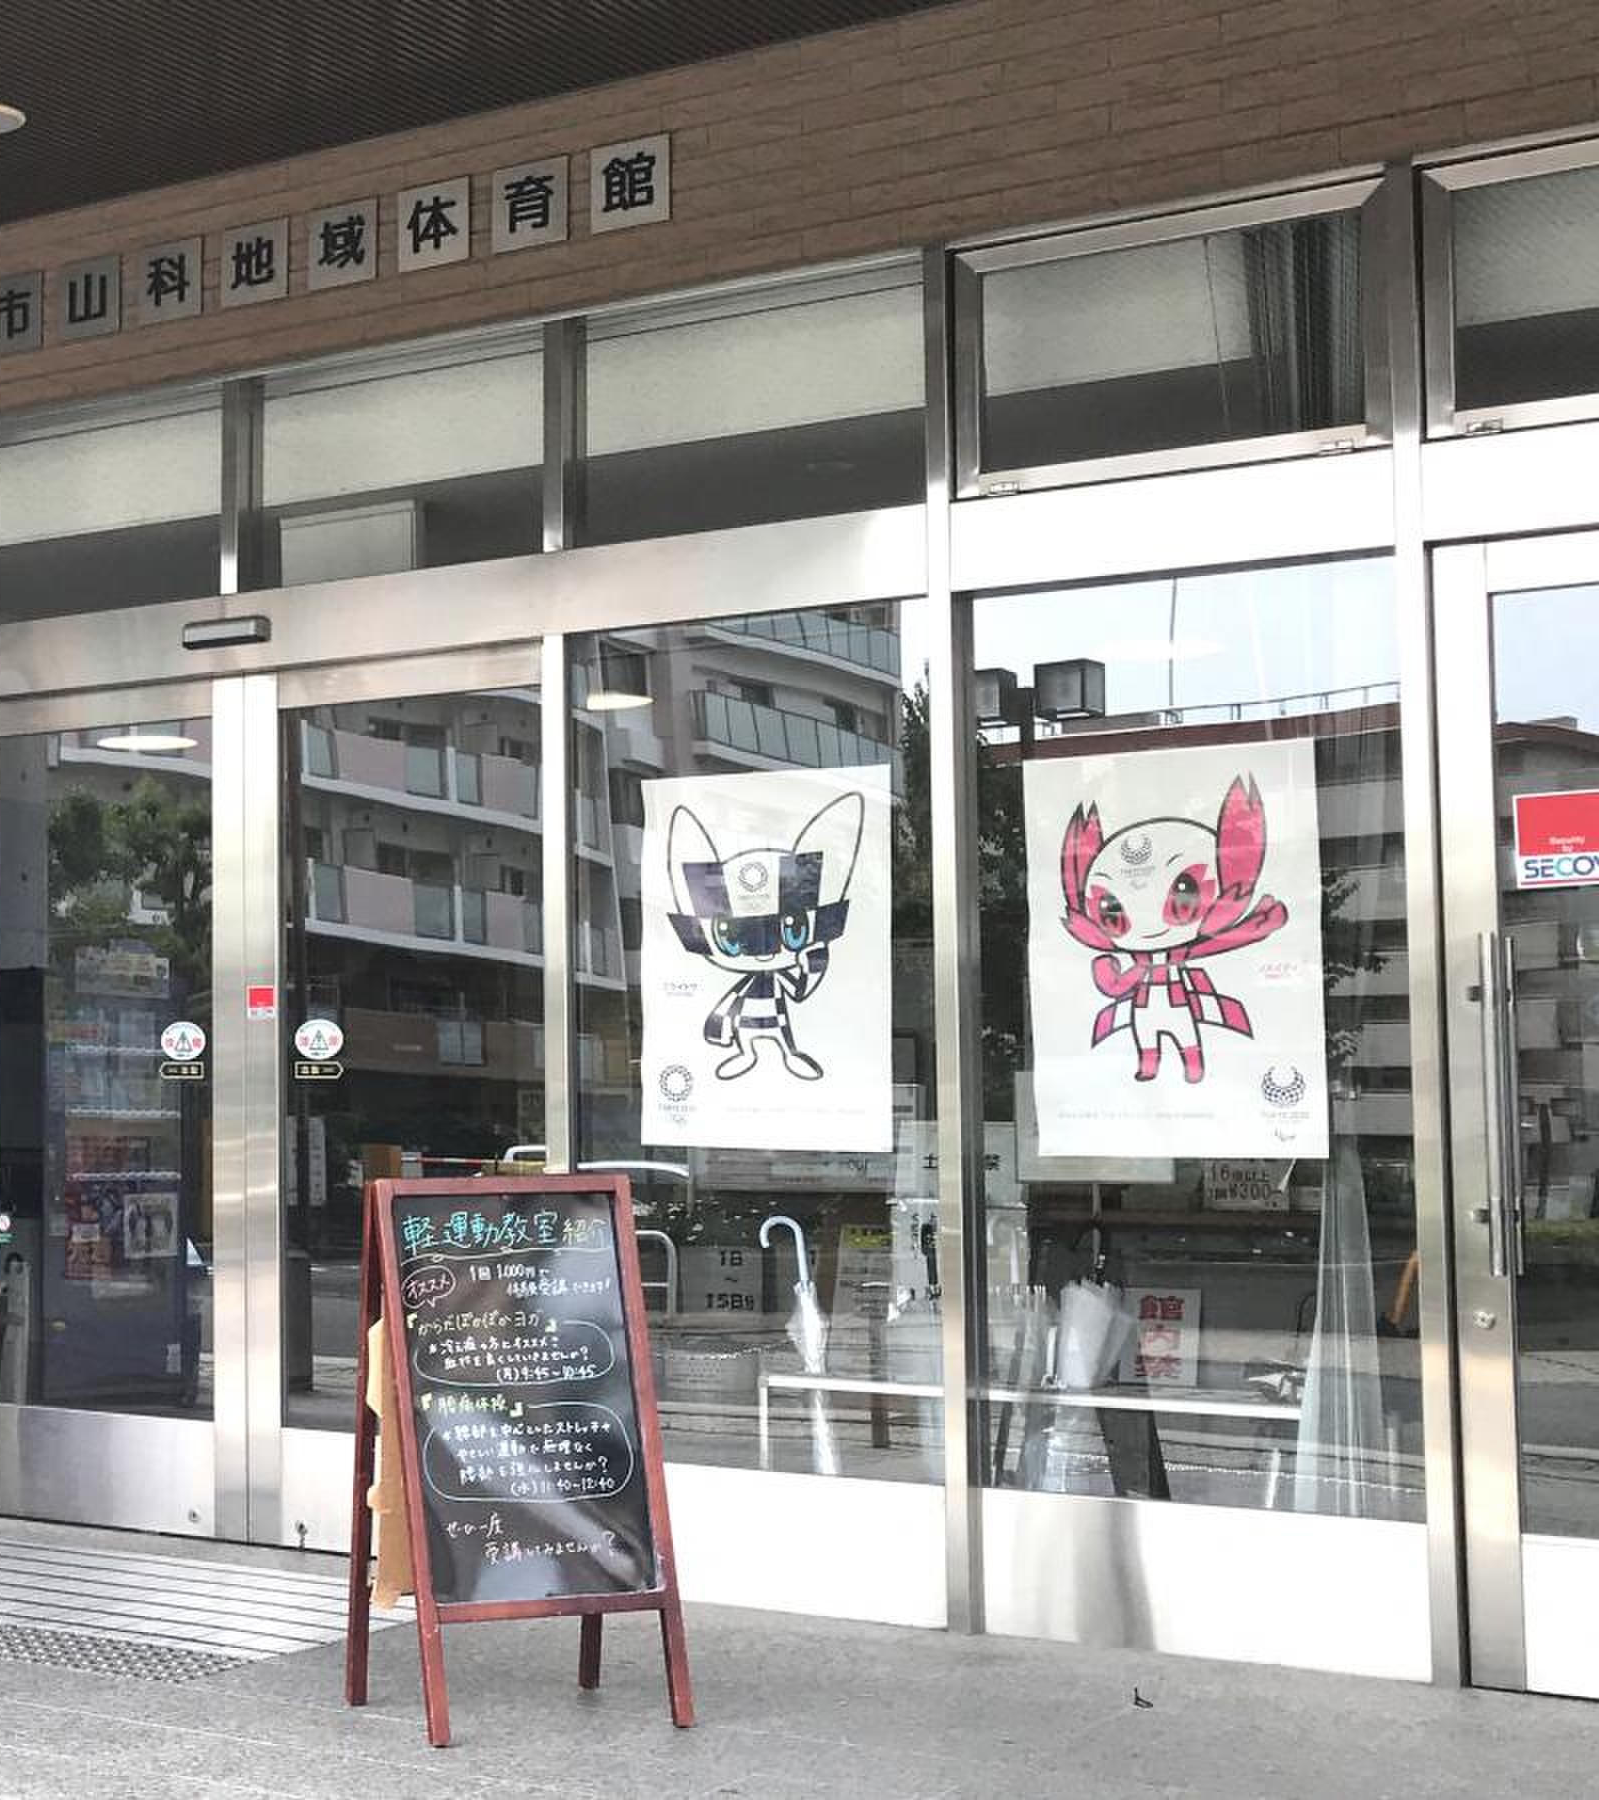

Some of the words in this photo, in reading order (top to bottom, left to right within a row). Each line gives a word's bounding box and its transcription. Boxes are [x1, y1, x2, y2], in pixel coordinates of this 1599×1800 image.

[1524, 855, 1599, 879] SECO
[402, 1211, 609, 1256] 軽運動教室紹介
